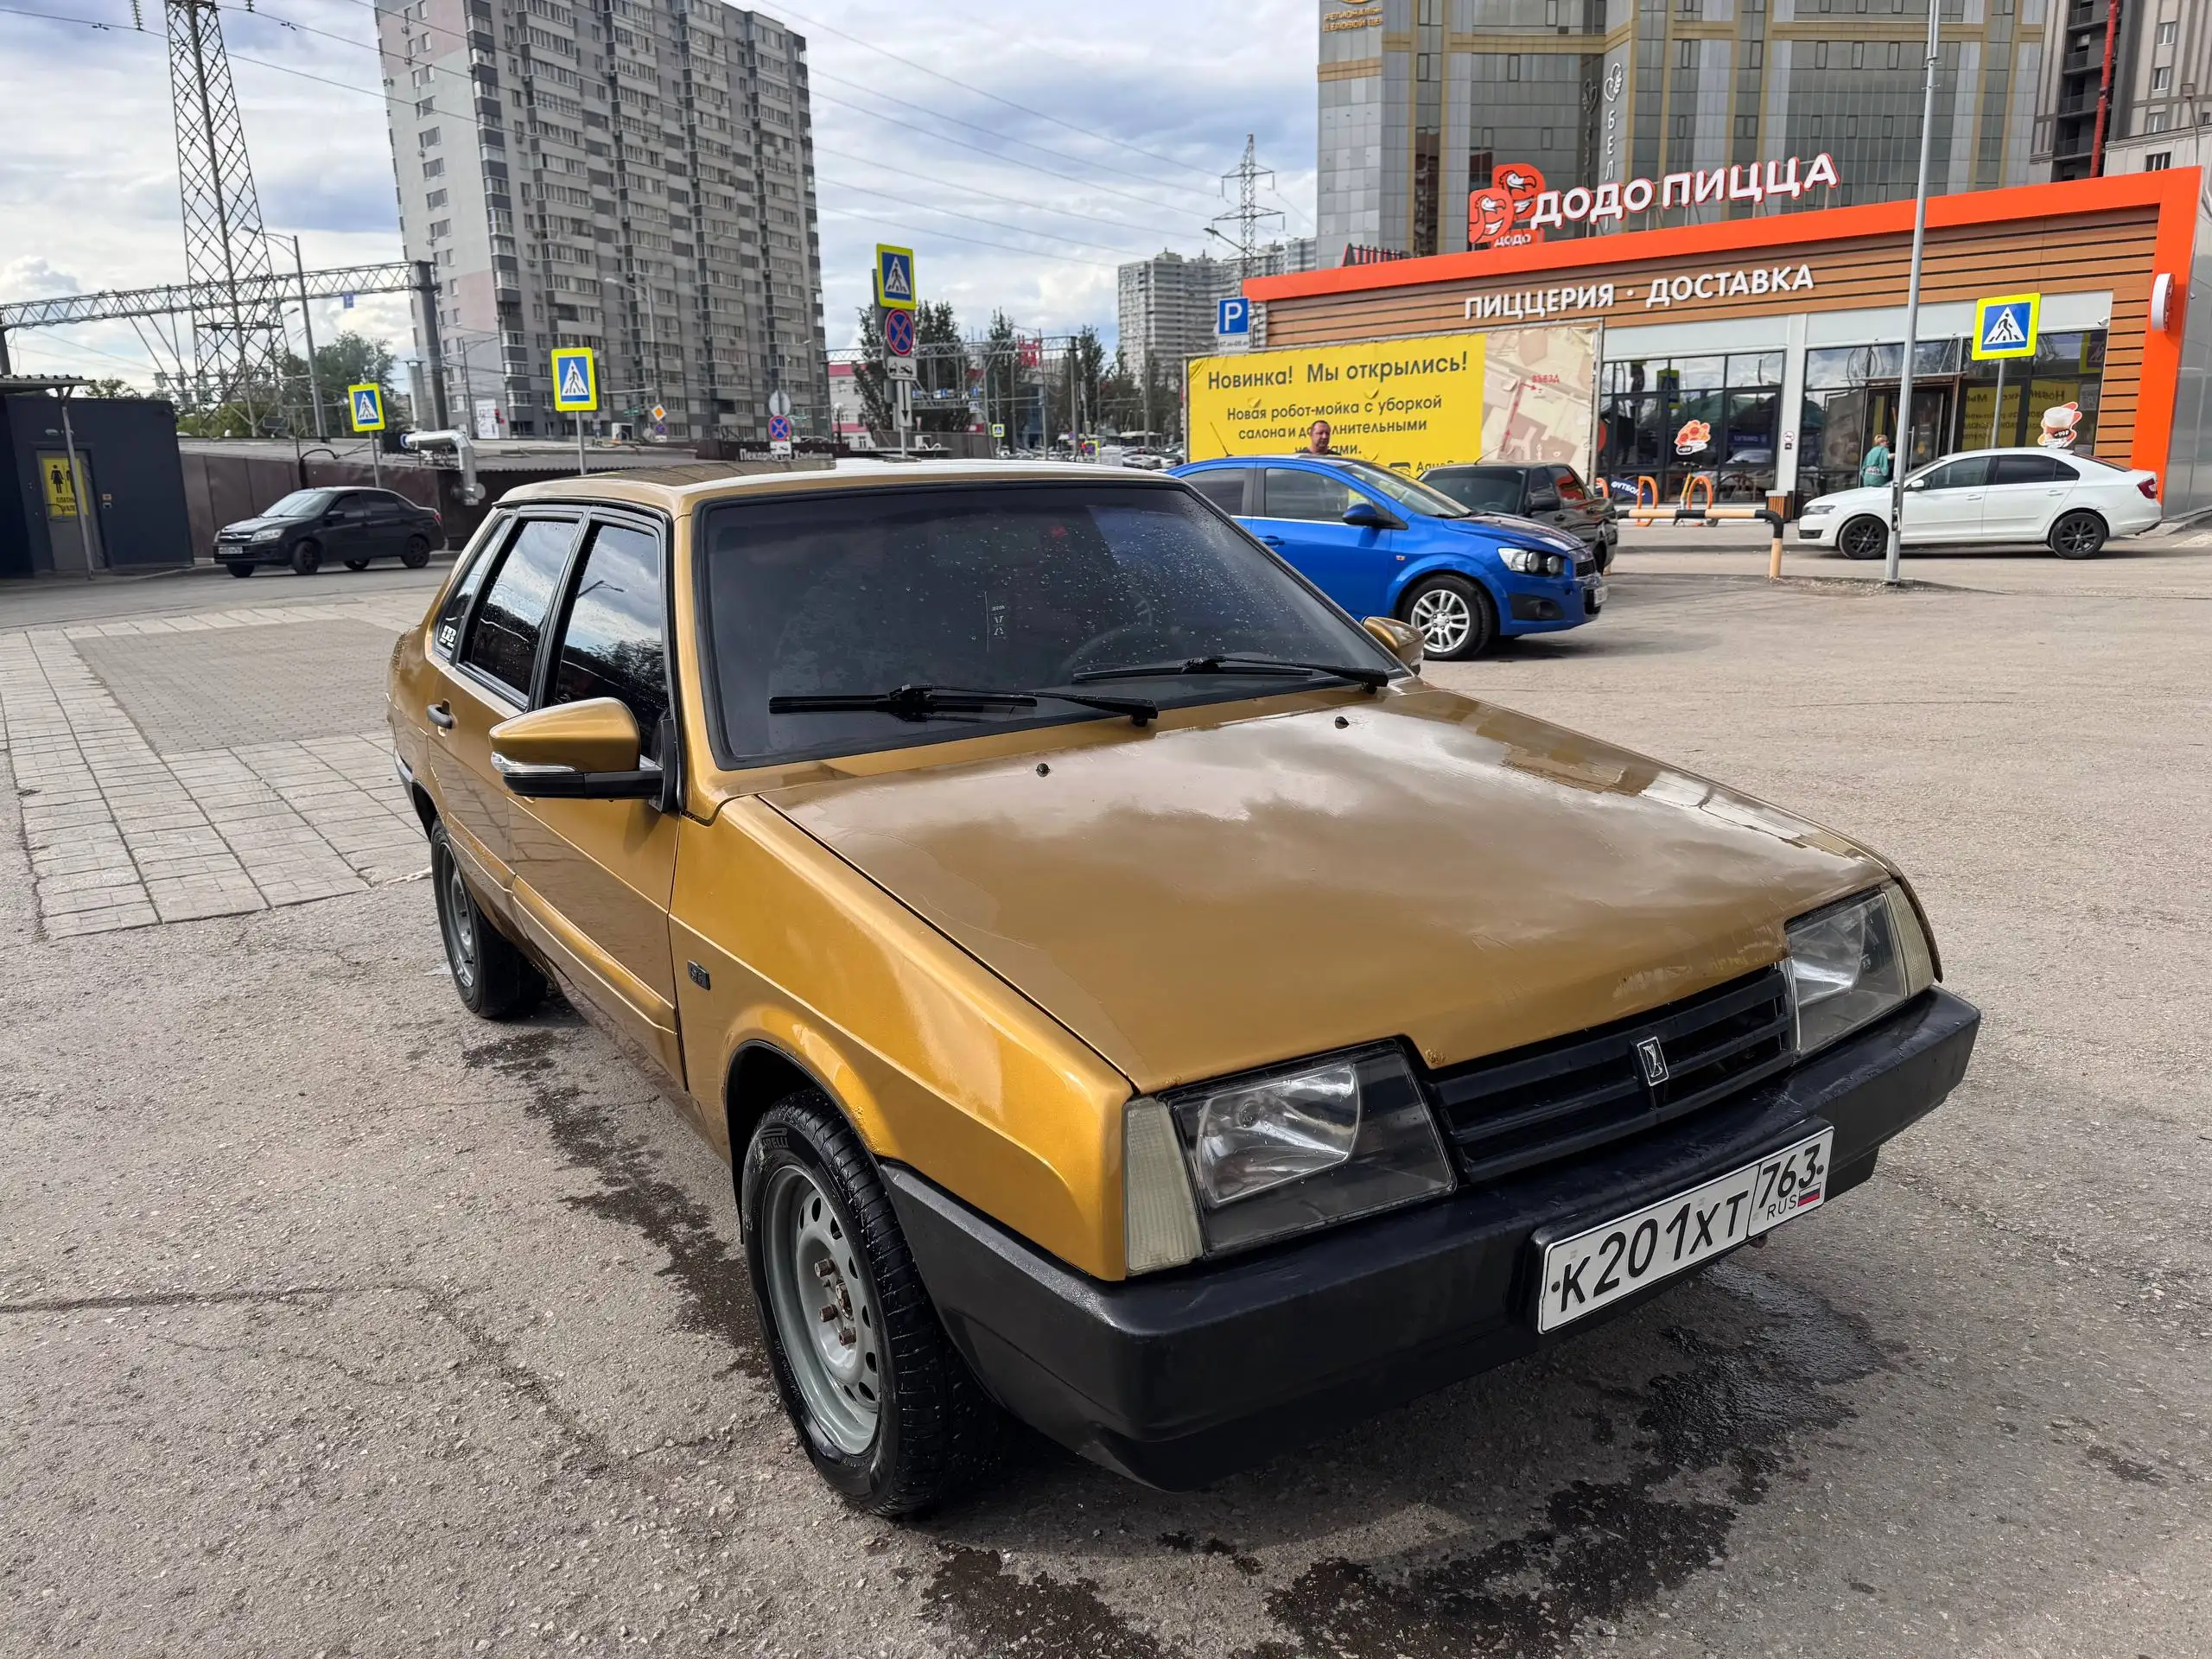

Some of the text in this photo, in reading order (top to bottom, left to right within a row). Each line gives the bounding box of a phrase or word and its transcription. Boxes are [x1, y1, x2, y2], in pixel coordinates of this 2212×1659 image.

[1530, 152, 1840, 230] ДОДО ПИЦЦА
[1493, 234, 1532, 247] ДОДО
[1464, 264, 1814, 321] ПИЦЦЕРИЯ ДОСТАВКА
[1208, 351, 1467, 390] Новинка! Мы открылись!
[1227, 395, 1442, 422] Новая робот-мойка с уборкой
[1238, 428, 1286, 439] салона
[1287, 428, 1295, 437] и
[1767, 1195, 1797, 1221] RUS
[1560, 1143, 1821, 1313] К201ХТ 763
